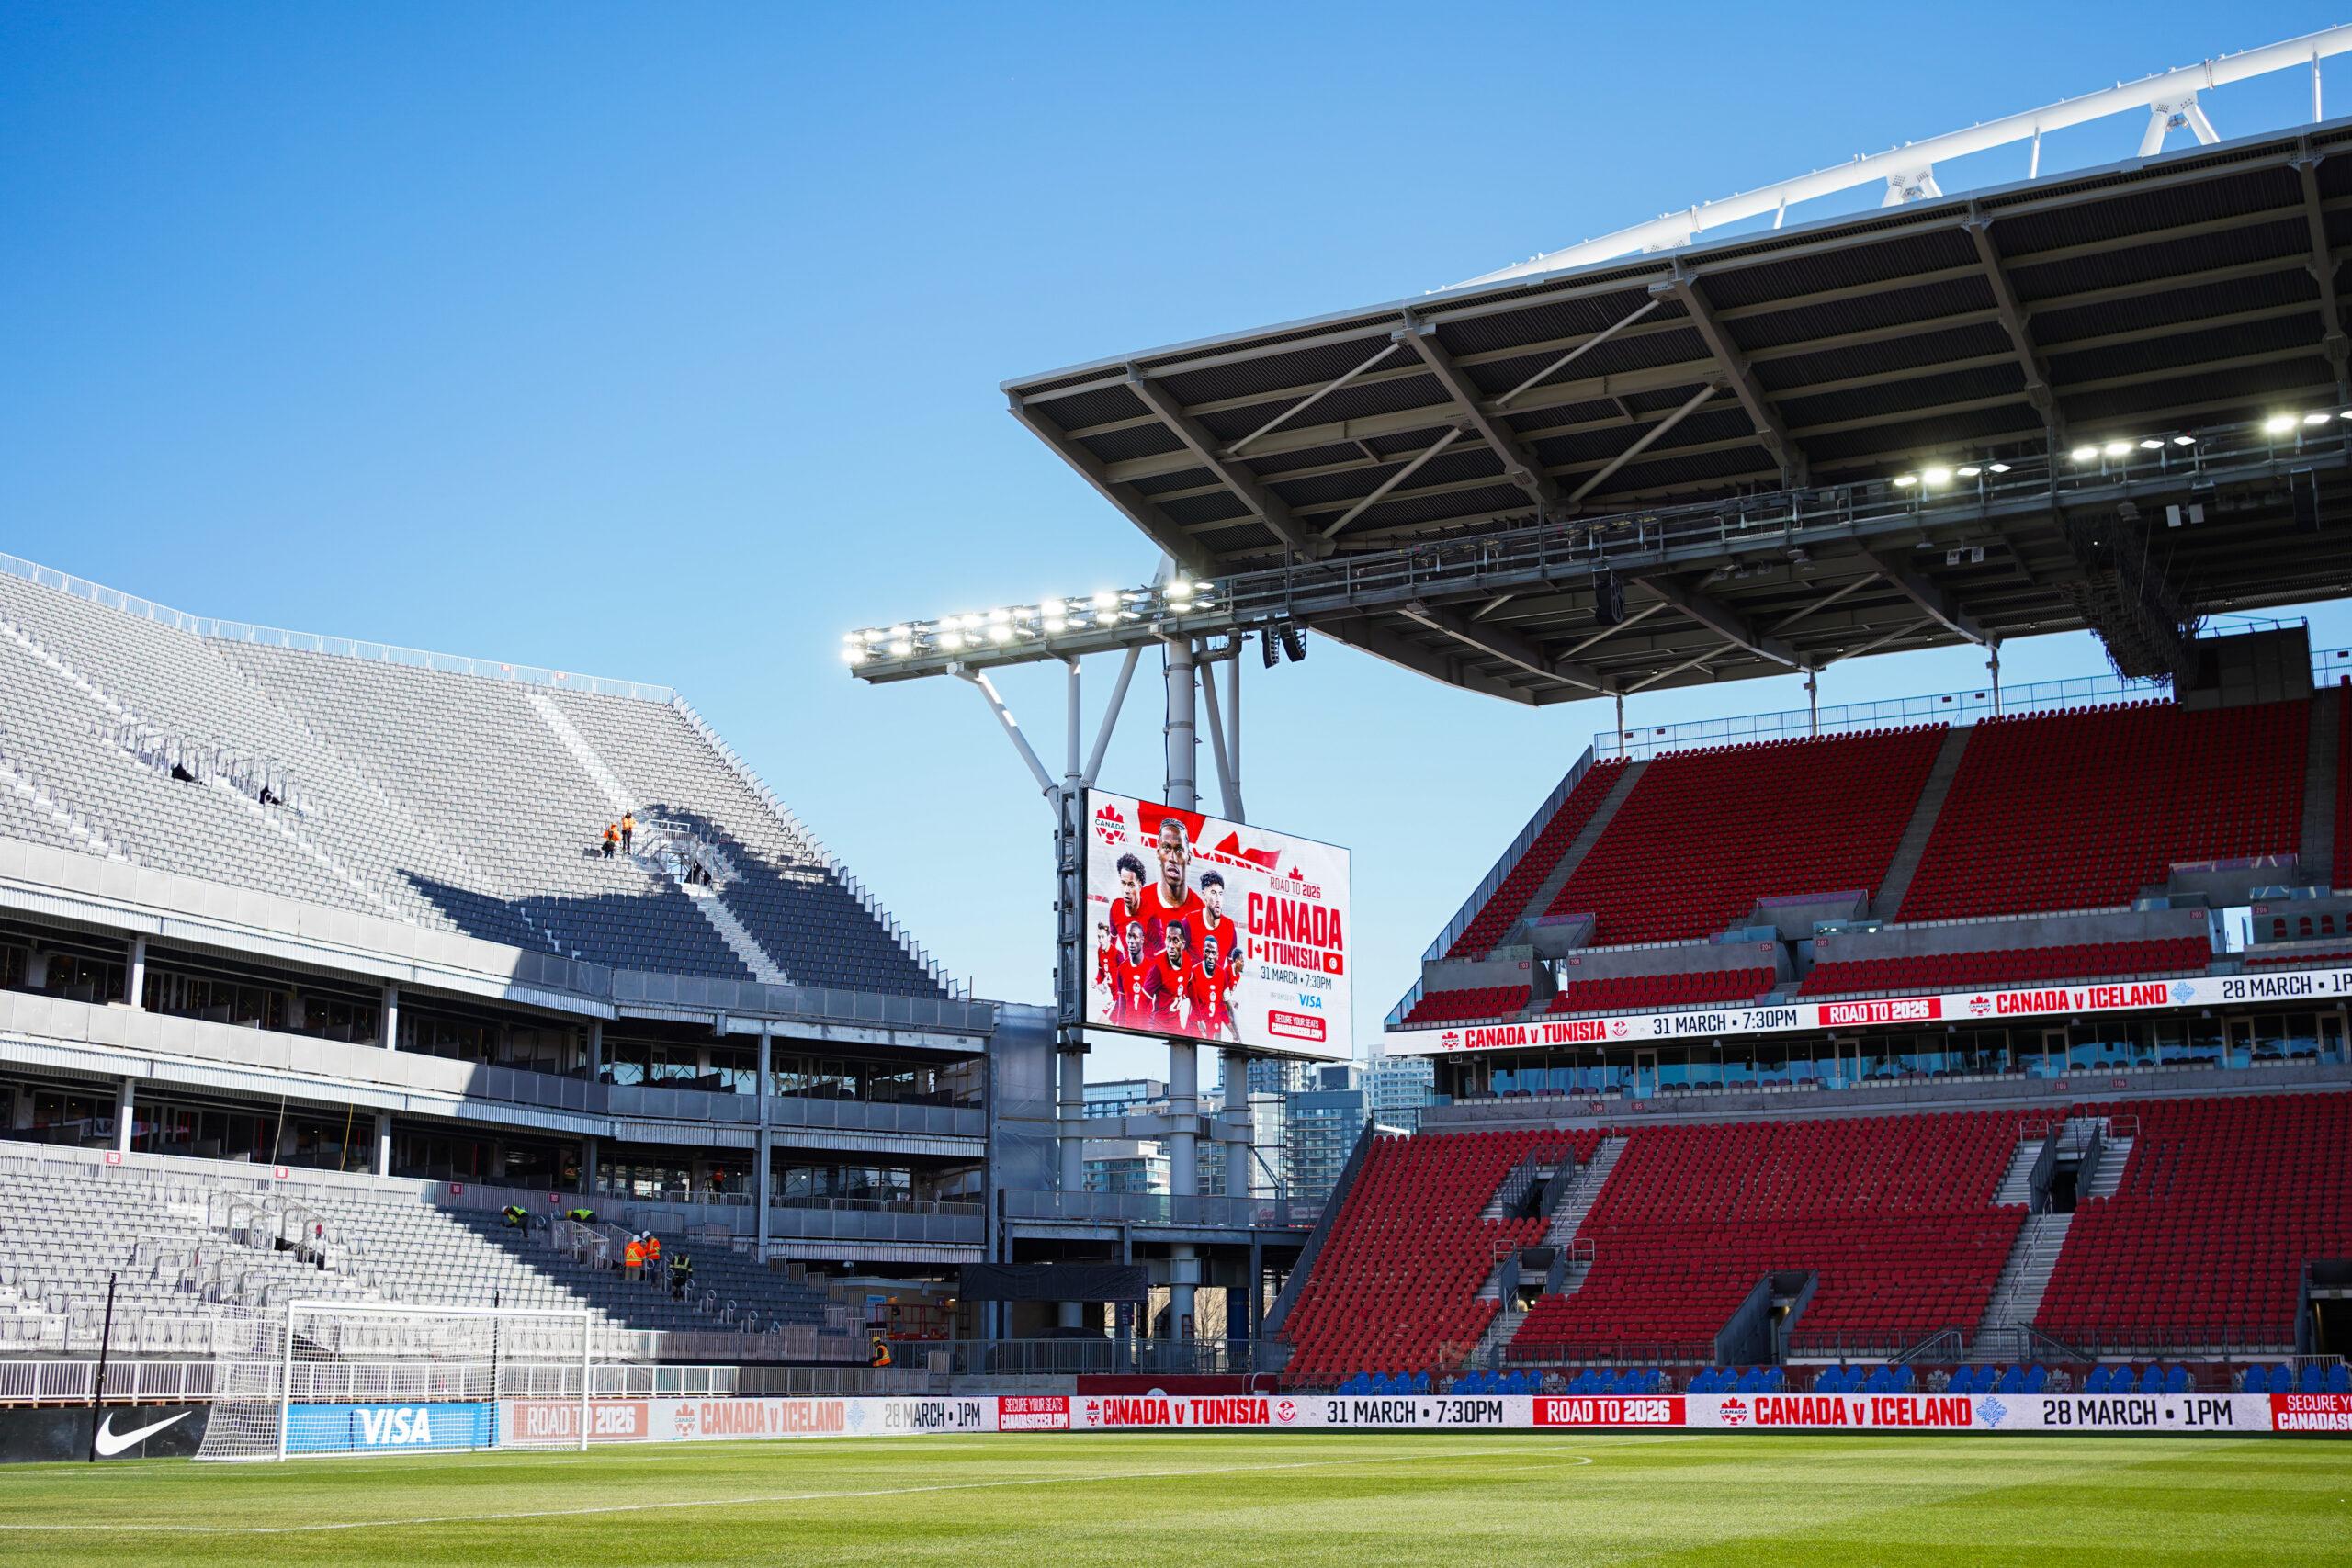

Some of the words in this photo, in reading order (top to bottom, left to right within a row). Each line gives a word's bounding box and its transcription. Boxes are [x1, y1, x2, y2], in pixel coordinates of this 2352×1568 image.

[1095, 819, 1125, 830] CANADA
[1270, 876, 1290, 893] ROAD
[1292, 880, 1300, 895] TO
[1302, 884, 1321, 899] 2026
[1248, 891, 1343, 951] CANADA
[1272, 942, 1321, 971] TUNISIA
[1261, 966, 1270, 980] 31
[1272, 968, 1298, 985] MARCH
[1306, 974, 1332, 990] 7:30PM
[2222, 979, 2245, 999] 28
[2249, 976, 2312, 998] MARCH
[1297, 993, 1322, 1009] VISA
[1997, 990, 2070, 1014] CANADA
[2074, 994, 2084, 1010] v
[2088, 984, 2168, 1008] ICELAND
[1653, 1017, 1670, 1035] 31
[1675, 1013, 1726, 1032] MARCH
[1743, 1010, 1798, 1030] 7:30PM
[1830, 1005, 1868, 1023] ROAD
[1870, 1003, 1889, 1021] TO
[1891, 1000, 1929, 1020] 2026
[1465, 1026, 1527, 1049] CANADA
[1530, 1029, 1539, 1044] v
[1543, 1021, 1607, 1043] TUNISIA
[1005, 1398, 1028, 1412] SECURE
[1029, 1398, 1045, 1411] YOUR
[1046, 1397, 1063, 1411] SEATS
[1103, 1399, 1170, 1425] CANADA
[1174, 1404, 1185, 1425] v
[1190, 1398, 1270, 1425] TUNISIA
[1327, 1401, 1348, 1423] 31
[1353, 1401, 1416, 1423] MARCH
[1436, 1401, 1503, 1423] 7:30PM
[1547, 1401, 1594, 1423] ROAD
[1597, 1401, 1620, 1423] TO
[1623, 1400, 1671, 1422] 2026
[1754, 1397, 1847, 1425] CANADA
[1852, 1404, 1865, 1426] v
[1871, 1397, 1973, 1426] ICELAND
[2042, 1400, 2072, 1425] 28
[2077, 1400, 2157, 1425] MARCH
[2183, 1400, 2233, 1425] 1PM
[2287, 1394, 2338, 1411] SECURE
[2340, 1395, 2352, 1411] Y
[356, 1408, 432, 1444] VISA
[528, 1406, 570, 1435] ROAD
[595, 1405, 636, 1434] 2026
[700, 1402, 766, 1435] CANADA
[770, 1407, 779, 1433] v
[782, 1401, 845, 1432] ICELAND
[885, 1403, 900, 1427] 28
[903, 1403, 944, 1427] MARCH
[957, 1403, 981, 1427] 1PM
[1001, 1413, 1068, 1429] CANADASOCCER.COM
